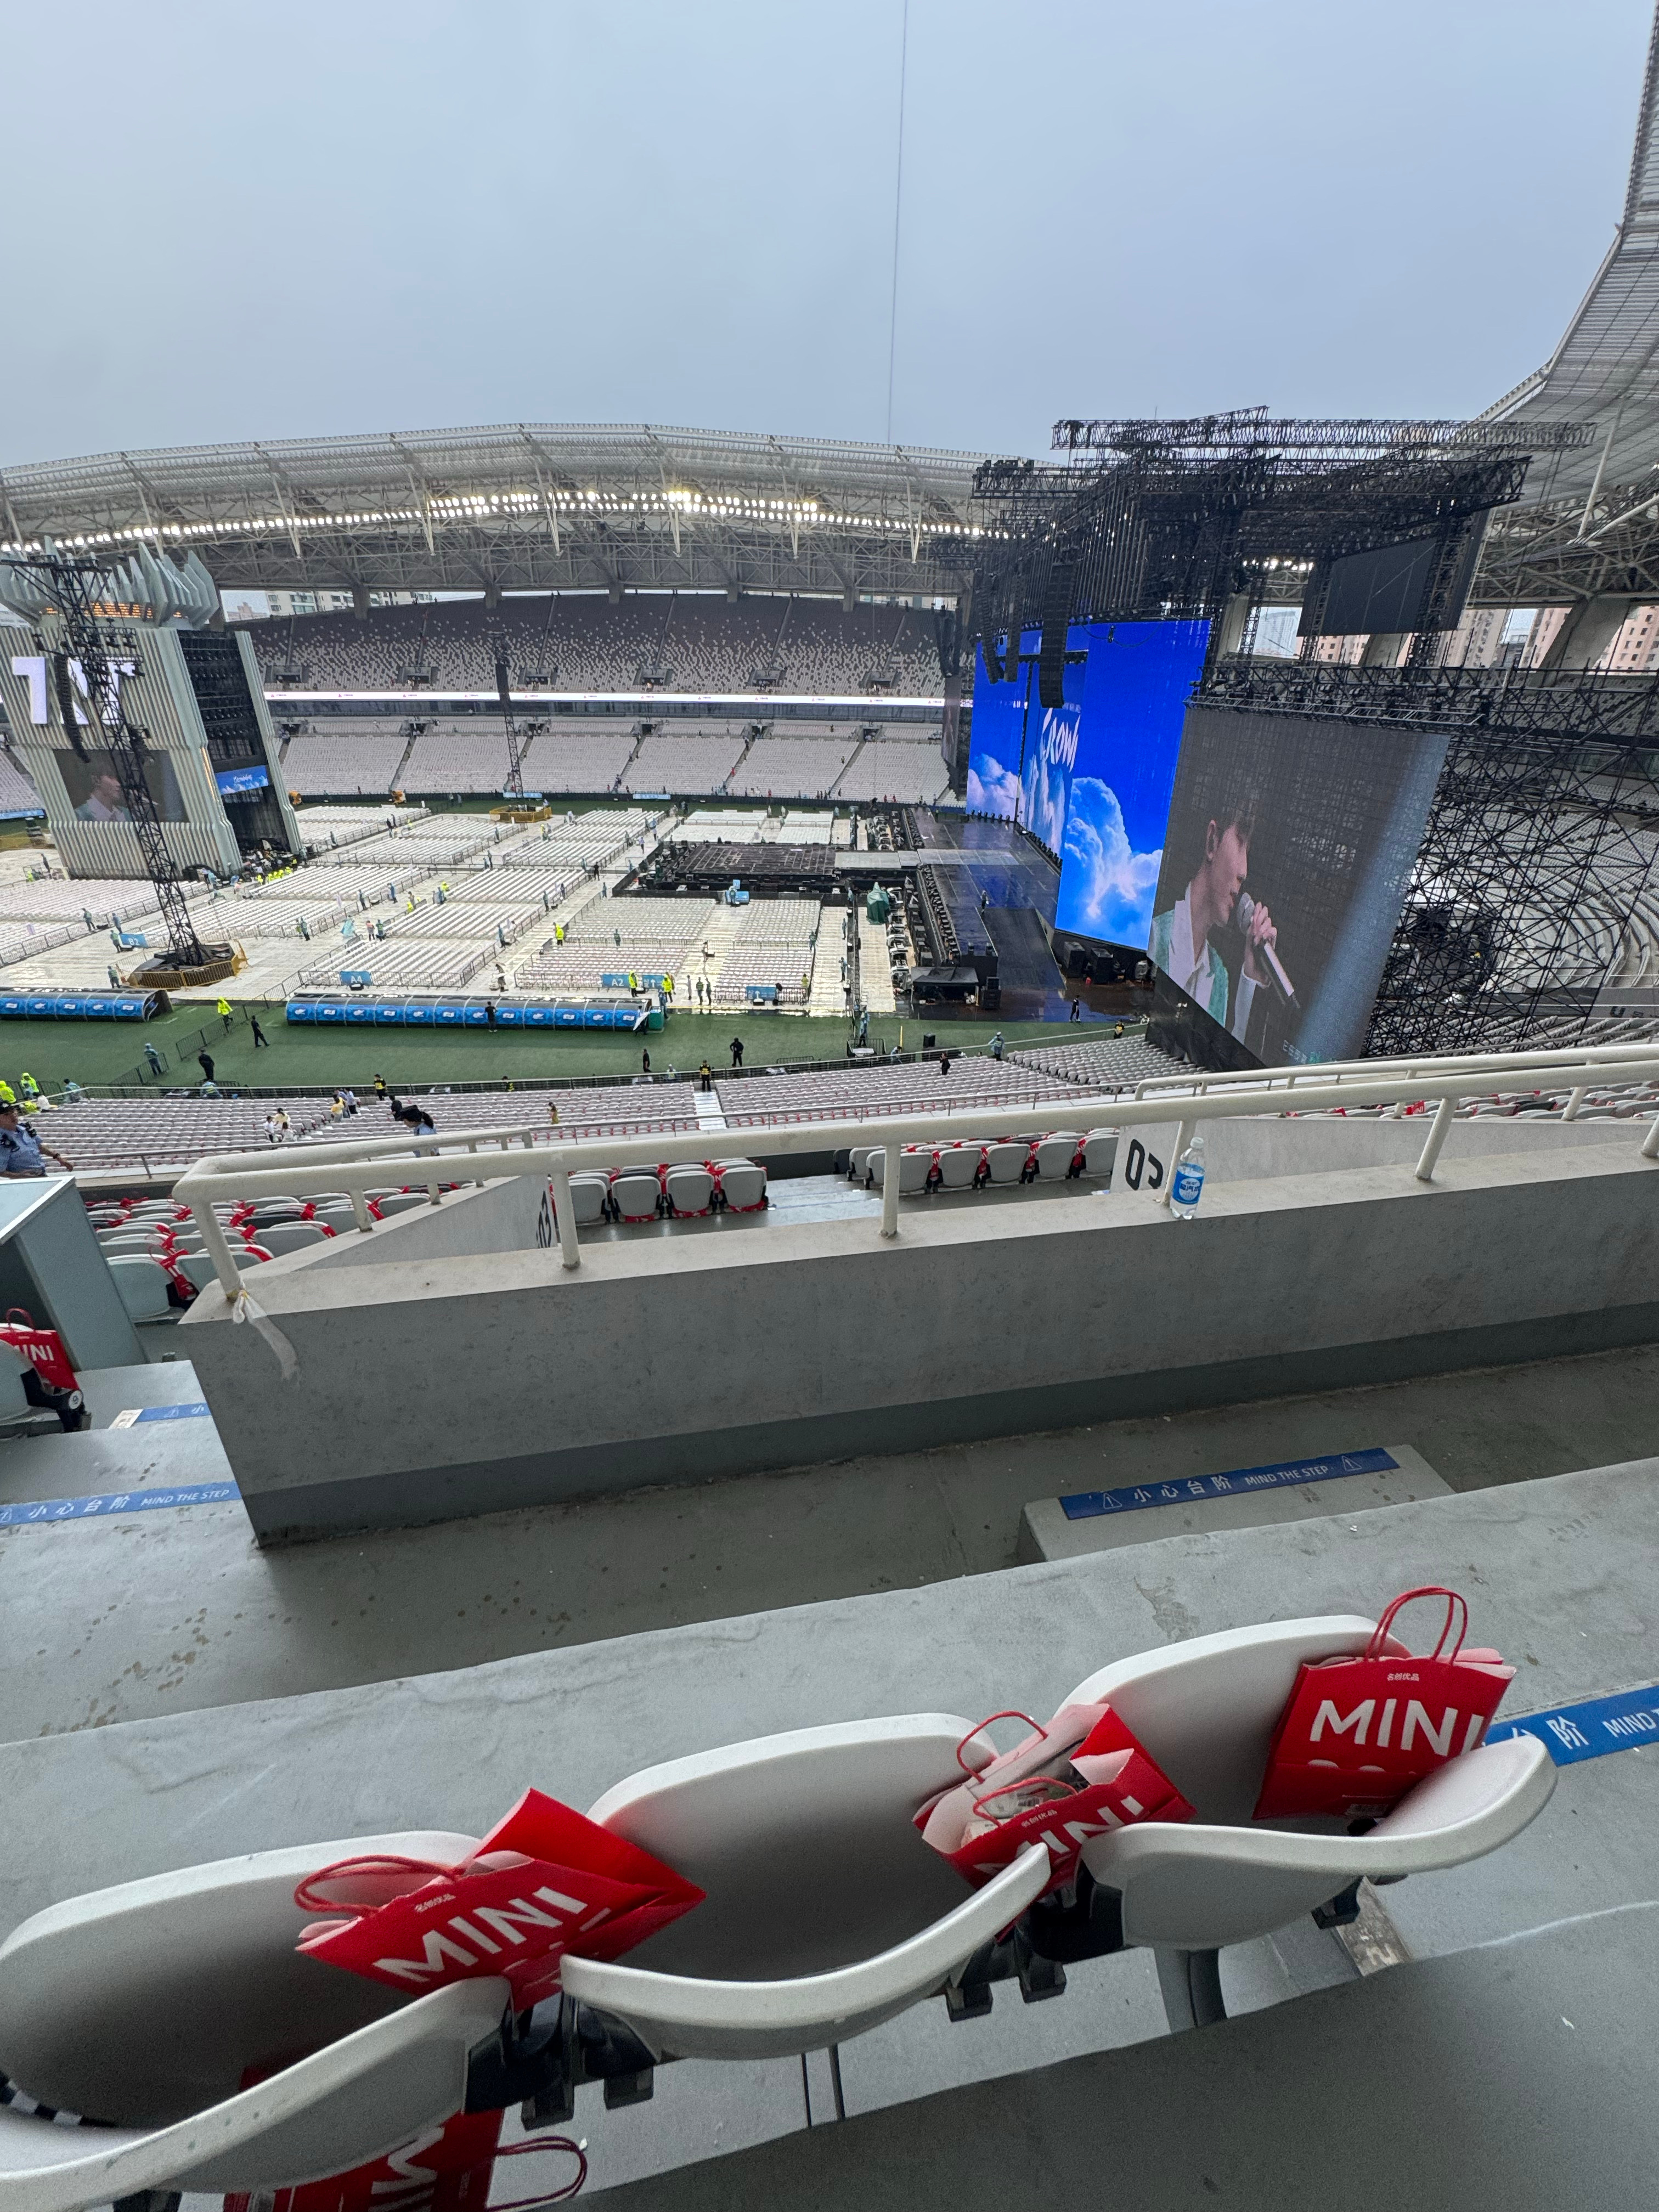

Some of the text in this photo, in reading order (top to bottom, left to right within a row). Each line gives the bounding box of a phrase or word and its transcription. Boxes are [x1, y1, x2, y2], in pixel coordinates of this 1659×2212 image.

[611, 978, 624, 986] A2
[536, 1190, 552, 1248] 03
[29, 1489, 230, 1519] 小心台阶 MIND THE STEP
[1134, 1465, 1329, 1503] 小心台阶 MIND THE STEP
[1310, 1698, 1485, 1757] MINI
[1601, 1712, 1656, 1738] MIND
[372, 1886, 588, 1983] MINI
[368, 2126, 445, 2212] MI
